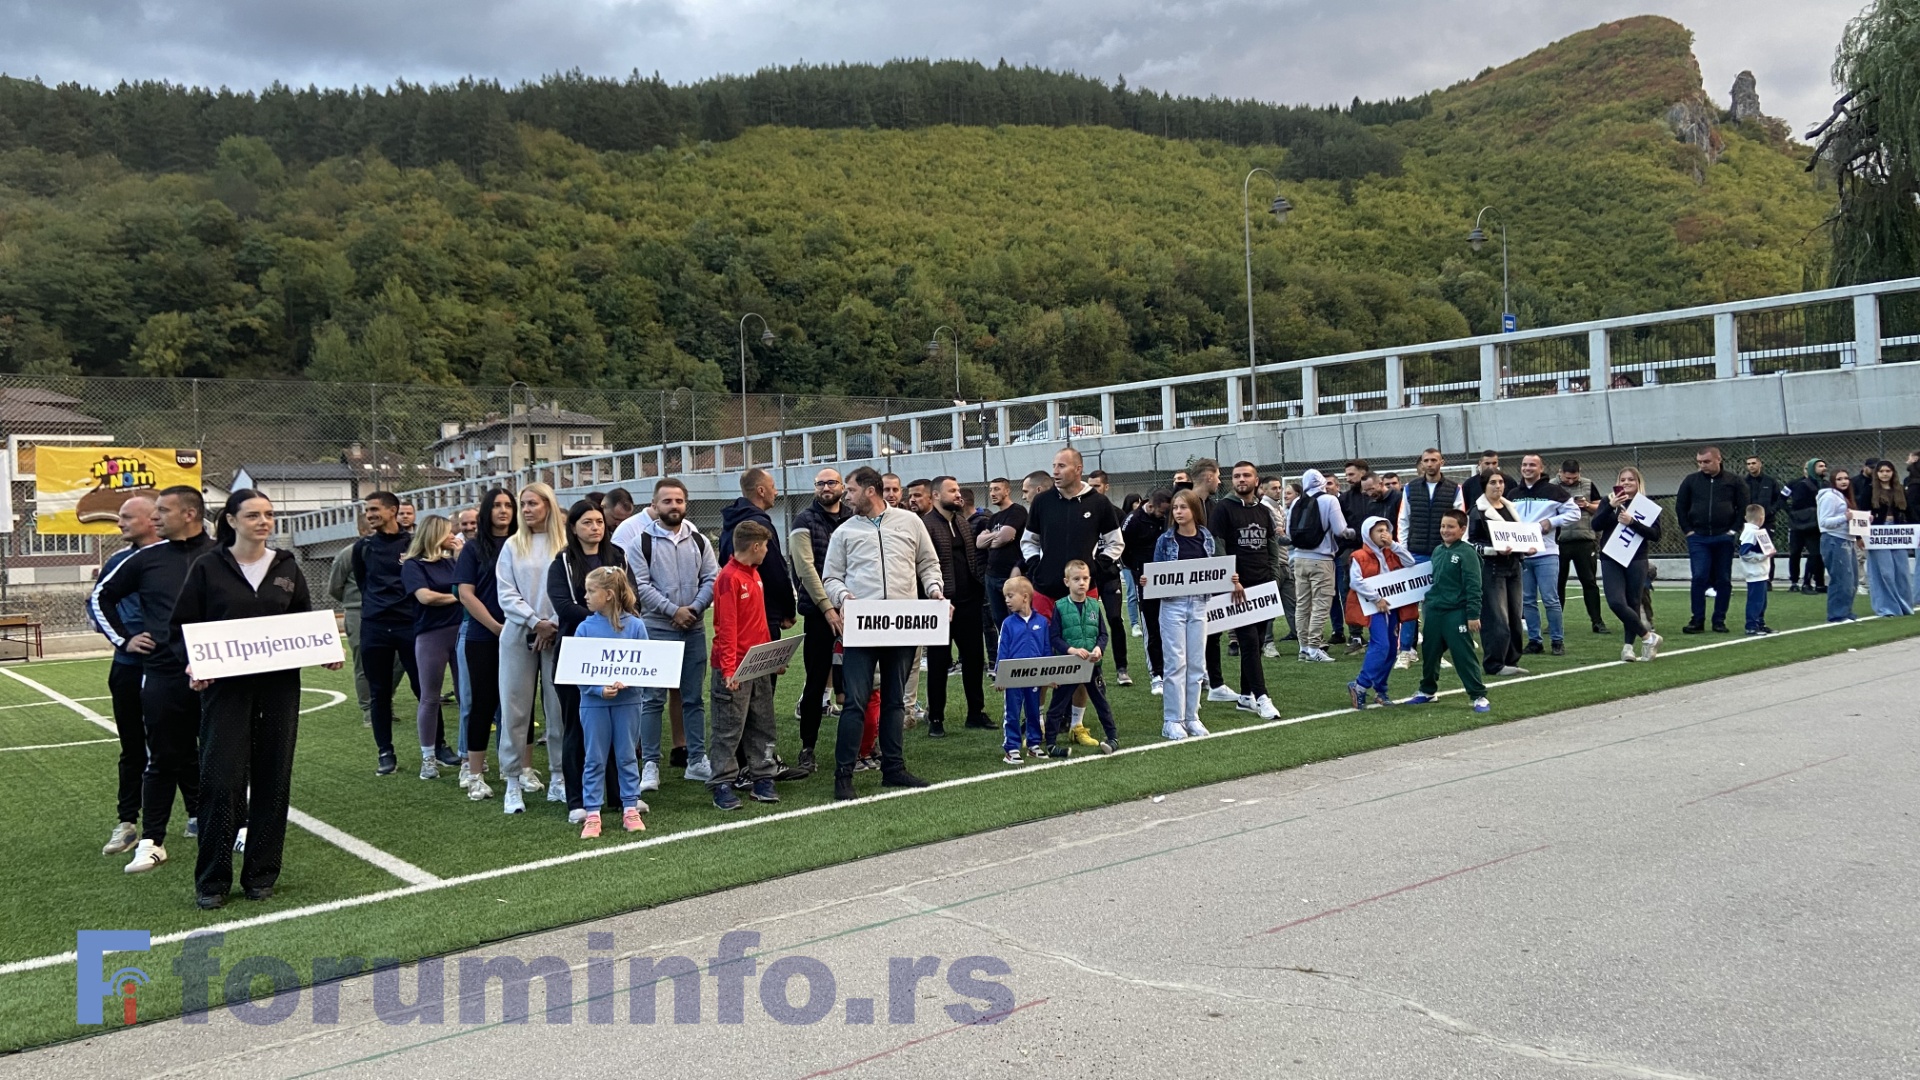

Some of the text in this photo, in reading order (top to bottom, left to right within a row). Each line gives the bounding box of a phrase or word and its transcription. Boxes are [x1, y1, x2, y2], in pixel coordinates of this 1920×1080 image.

[1239, 529, 1267, 538] VKV
[1493, 530, 1539, 543] КМР Човић
[1869, 536, 1913, 546] ЗАЈЕДНИЦА
[1153, 568, 1227, 586] ГОЛД ДЕКОР
[1408, 574, 1434, 591] ПЛУС
[1226, 593, 1279, 617] МАЈСТОРИ
[856, 615, 938, 630] ТАКО-ОВАКО
[192, 632, 334, 664] ЗЦ Пријепоље
[749, 644, 793, 664] ОПШТИНА
[600, 649, 642, 664] МУП
[581, 662, 658, 678] Пријепоље
[738, 654, 790, 677] ПРИЈЕПОЉЕ
[1010, 664, 1082, 678] МИС КОЛОР
